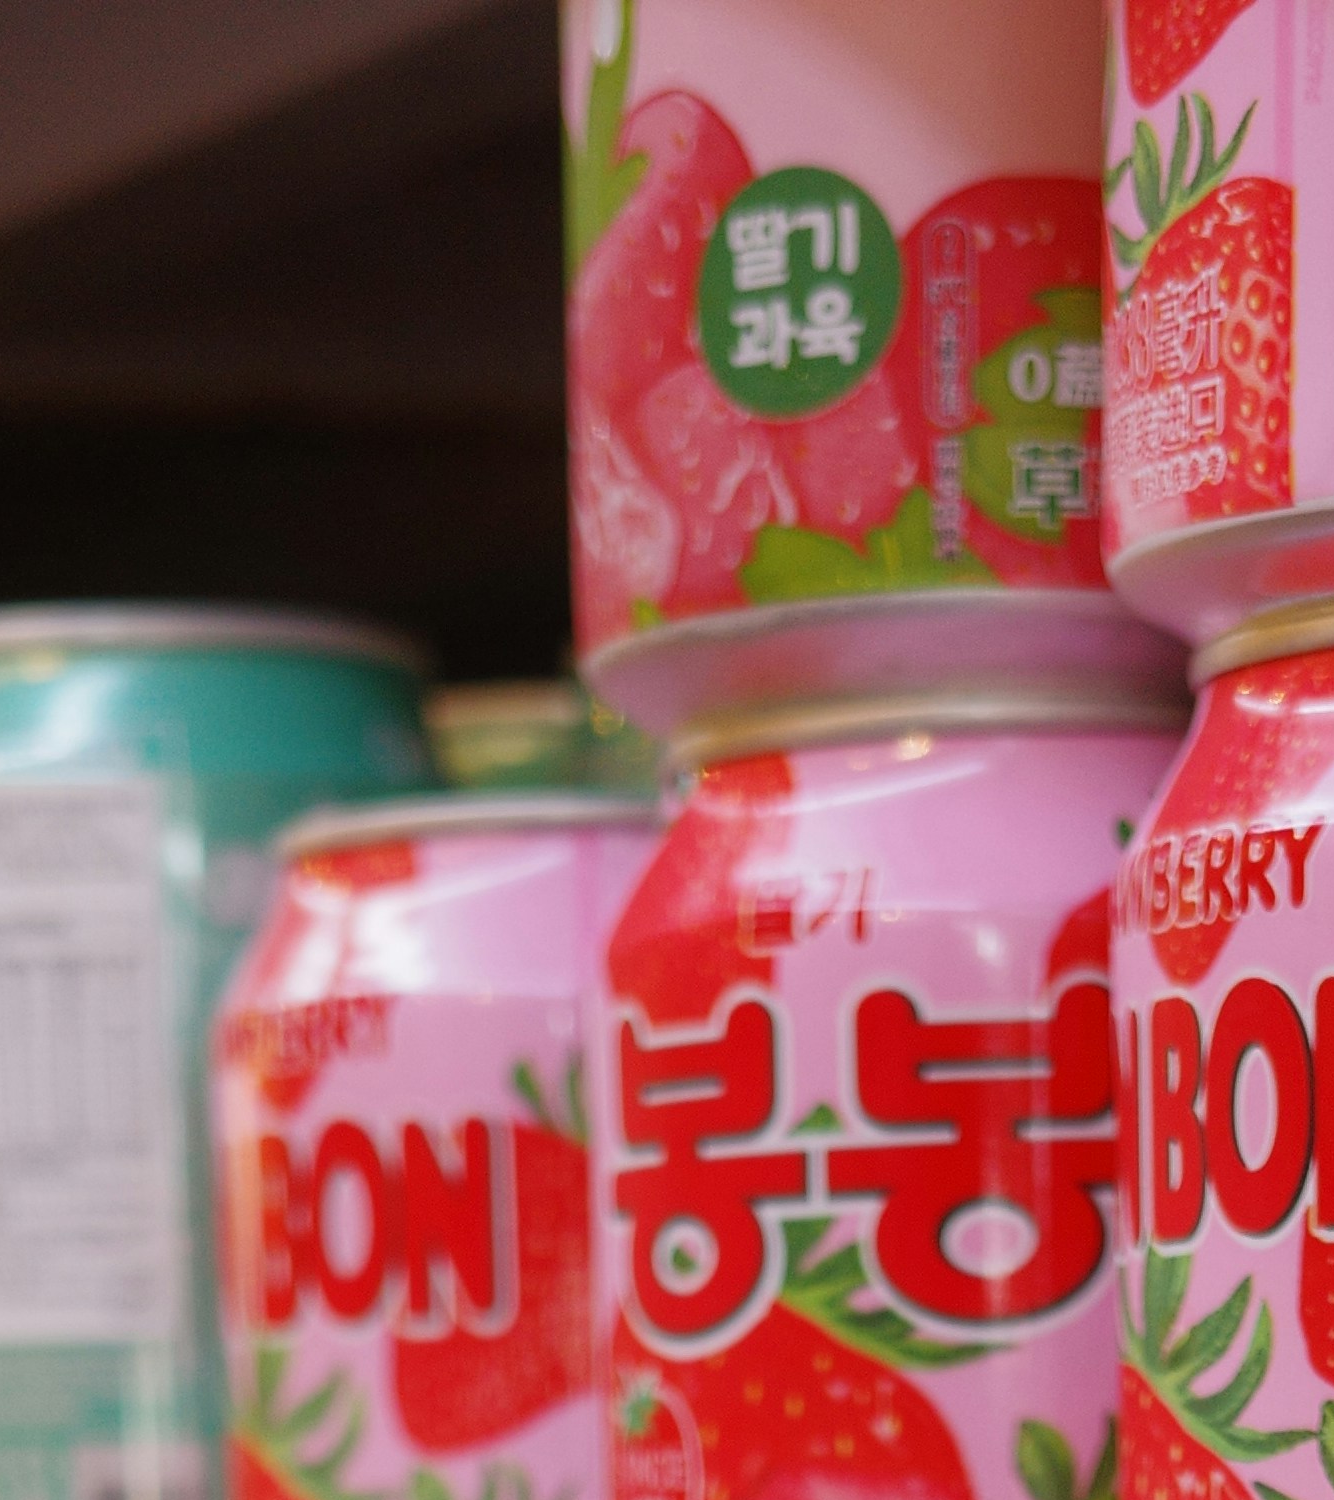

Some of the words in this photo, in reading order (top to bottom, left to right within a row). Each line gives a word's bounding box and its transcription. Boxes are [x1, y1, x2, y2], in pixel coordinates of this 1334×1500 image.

[725, 203, 861, 291] 딸기
[729, 289, 864, 370] 과육
[1007, 440, 1103, 531] 草
[1115, 815, 1327, 935] BERRY
